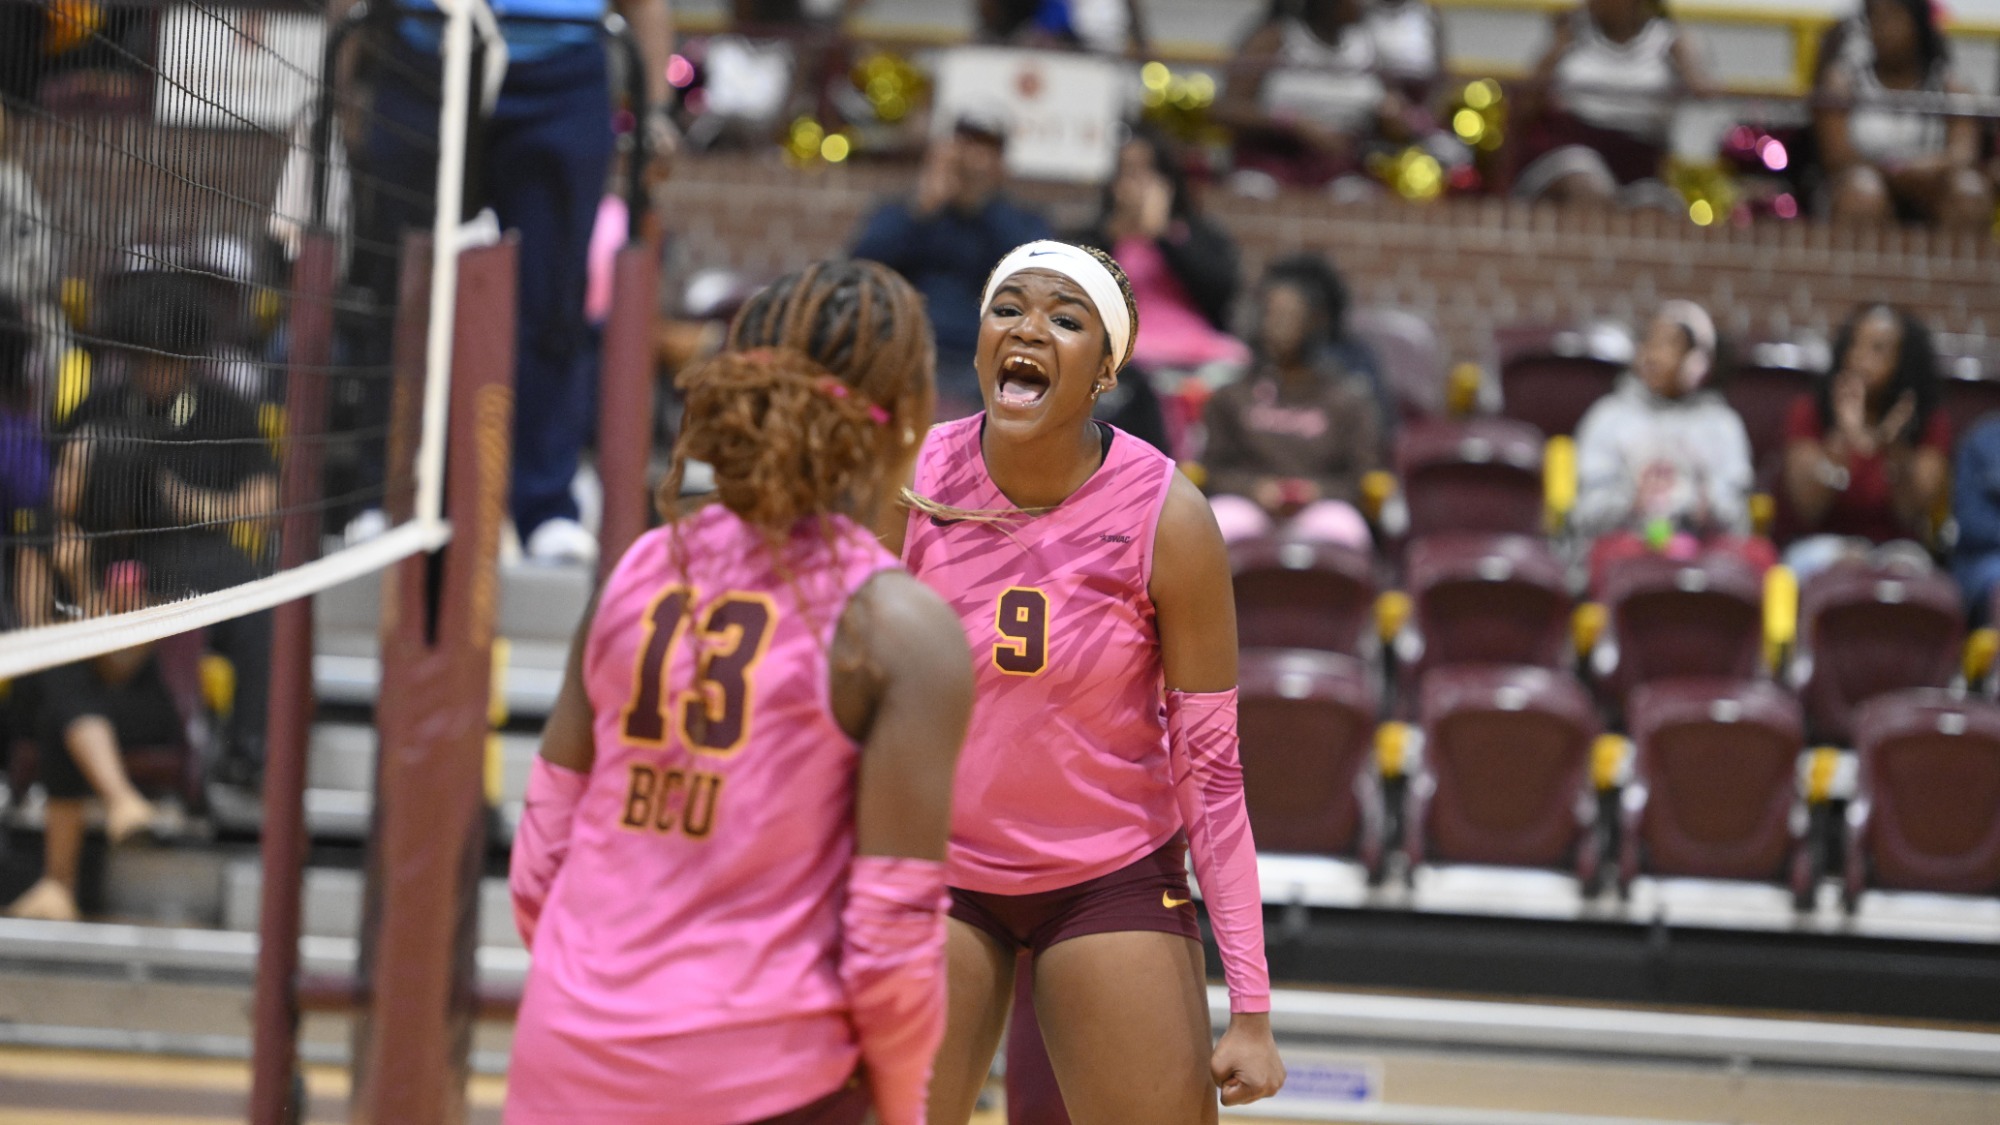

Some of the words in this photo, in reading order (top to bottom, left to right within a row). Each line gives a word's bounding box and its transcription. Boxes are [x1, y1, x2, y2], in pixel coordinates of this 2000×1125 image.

[1107, 535, 1130, 543] SWAC
[622, 583, 778, 758] 13
[992, 586, 1050, 677] 9
[622, 764, 722, 837] BCU
